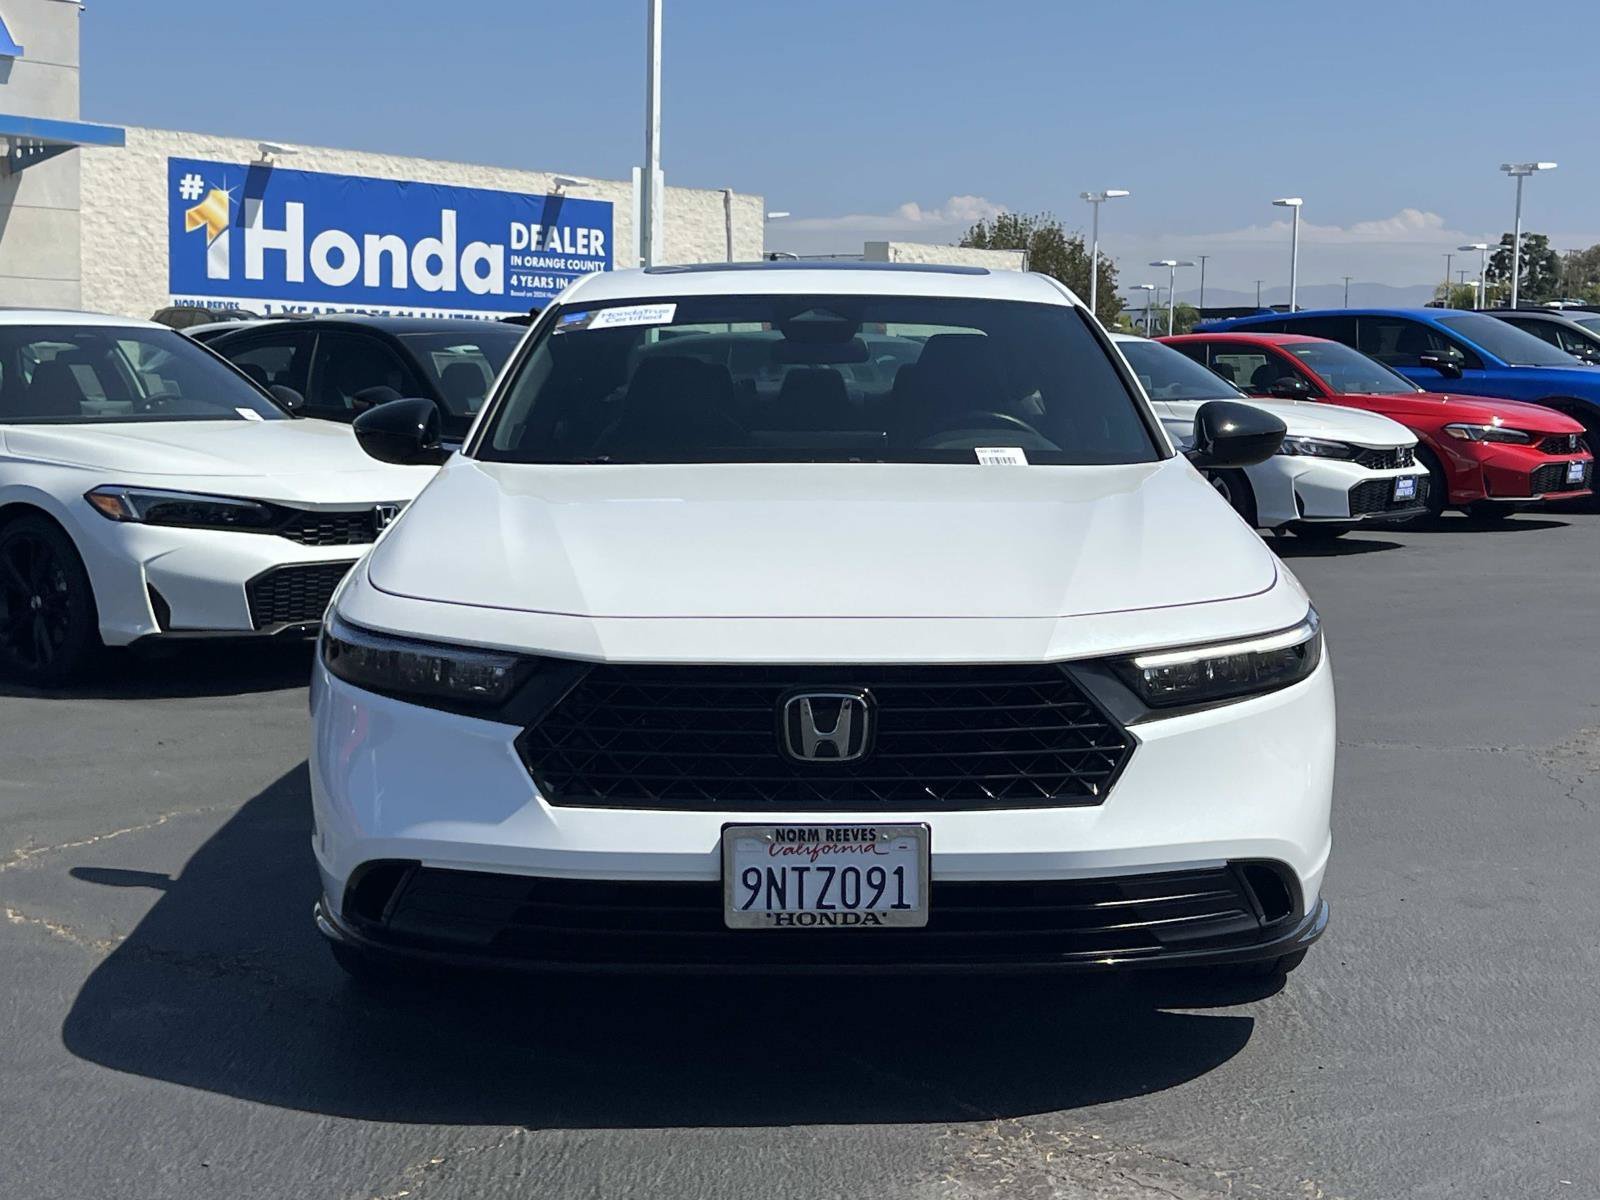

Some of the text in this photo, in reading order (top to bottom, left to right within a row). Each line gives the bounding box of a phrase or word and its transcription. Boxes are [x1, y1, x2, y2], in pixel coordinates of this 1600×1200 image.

[244, 198, 505, 295] Honda
[510, 222, 606, 257] DEALER
[510, 255, 606, 272] IN ORANGE COUNTY
[510, 275, 518, 287] 4
[520, 275, 554, 288] YEARS
[556, 277, 569, 289] IN
[174, 299, 205, 309] NORM
[775, 828, 877, 842] NORM REEVES
[768, 842, 889, 863] California
[741, 866, 911, 910] 9NTZ091
